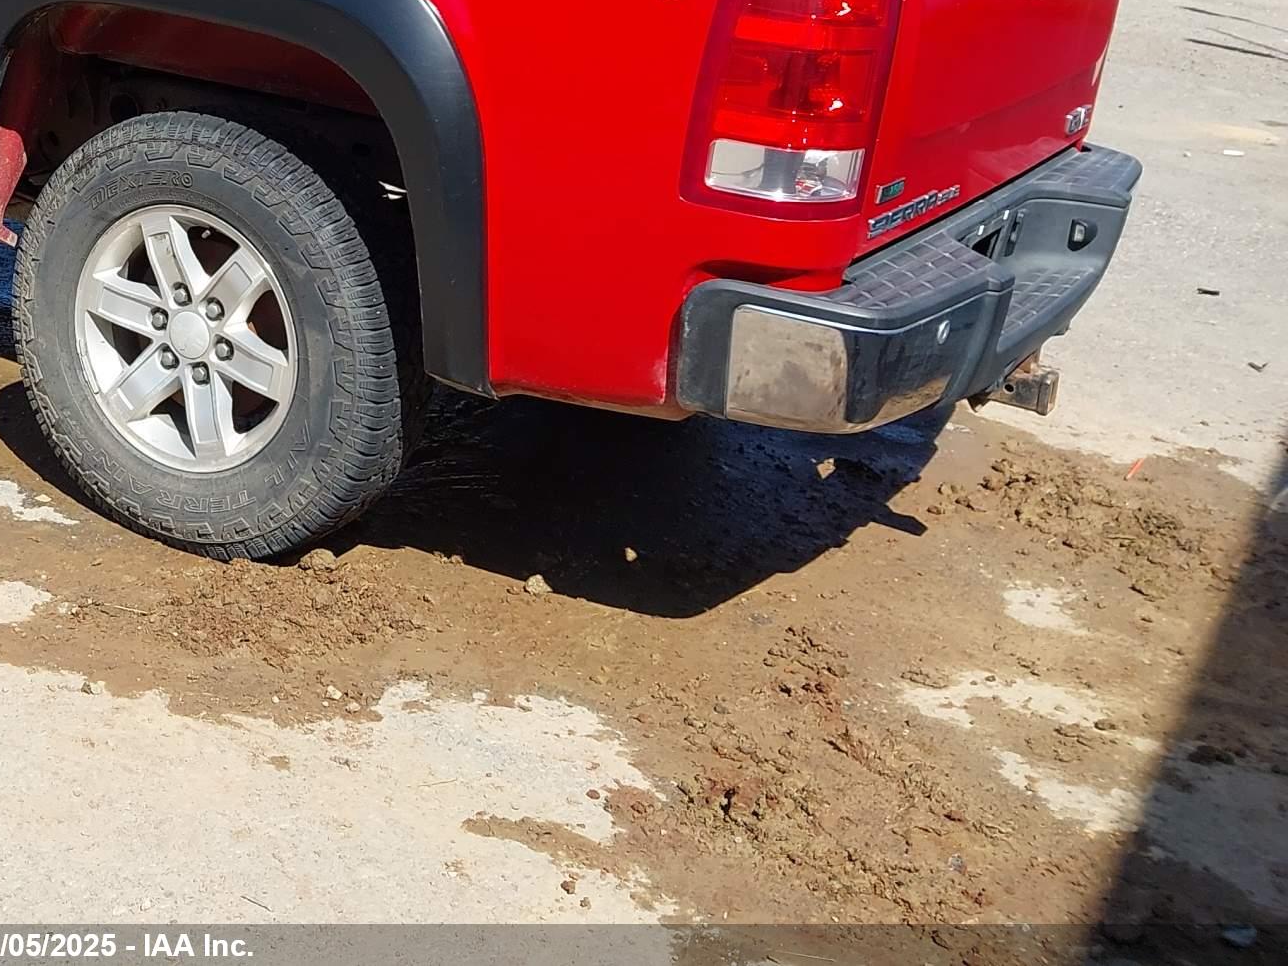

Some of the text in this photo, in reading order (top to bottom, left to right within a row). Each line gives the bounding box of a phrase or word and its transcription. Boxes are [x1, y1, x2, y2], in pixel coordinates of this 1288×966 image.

[86, 170, 193, 209] DEXTERO
[867, 189, 938, 239] SERRA
[93, 448, 256, 514] TERRAIN
